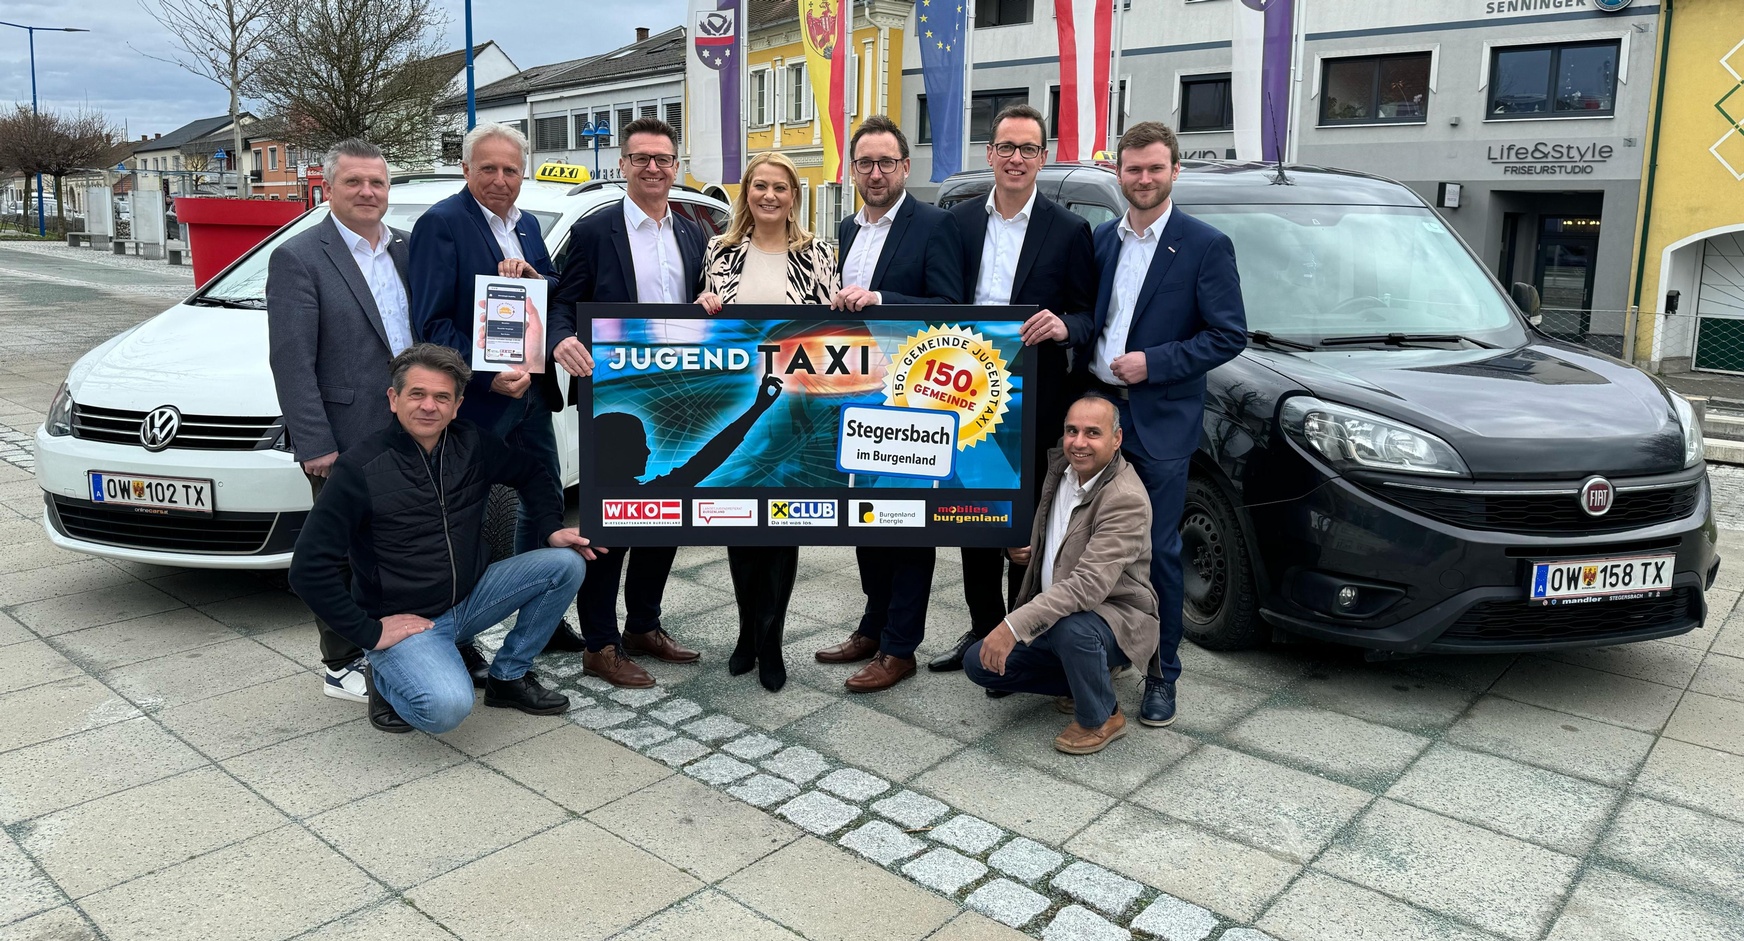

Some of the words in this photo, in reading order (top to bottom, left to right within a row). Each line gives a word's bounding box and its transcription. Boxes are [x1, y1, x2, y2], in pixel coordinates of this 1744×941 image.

[1487, 142, 1613, 162] Life&Style
[541, 166, 579, 178] TAXI
[1504, 165, 1593, 175] FRISEURSTUDIO
[608, 347, 750, 370] JUGEND
[757, 343, 869, 375] TAXI
[895, 370, 908, 396] 150.
[903, 337, 970, 366] GEMEINDE
[971, 348, 1000, 429] JUGENDTAXI
[923, 358, 978, 397] 150.
[913, 383, 977, 412] GEMEINDE
[846, 419, 950, 445] Stegersbach
[856, 449, 870, 460] im
[872, 450, 937, 466] Burgenland
[107, 478, 131, 500] OW
[145, 481, 178, 504] 102
[182, 484, 205, 507] TX
[1589, 489, 1609, 507] FIAT
[605, 503, 659, 518] WKO
[789, 502, 834, 518] CLUB
[879, 511, 916, 519] Burgenland
[937, 505, 989, 514] mobiles
[933, 513, 1009, 524] burgenland
[1537, 584, 1544, 593] A
[1551, 566, 1582, 592] OW
[1600, 562, 1634, 588] 158
[1641, 560, 1666, 586] TX
[1562, 597, 1603, 605] mandler
[1609, 593, 1644, 602] STEGERSBACH
